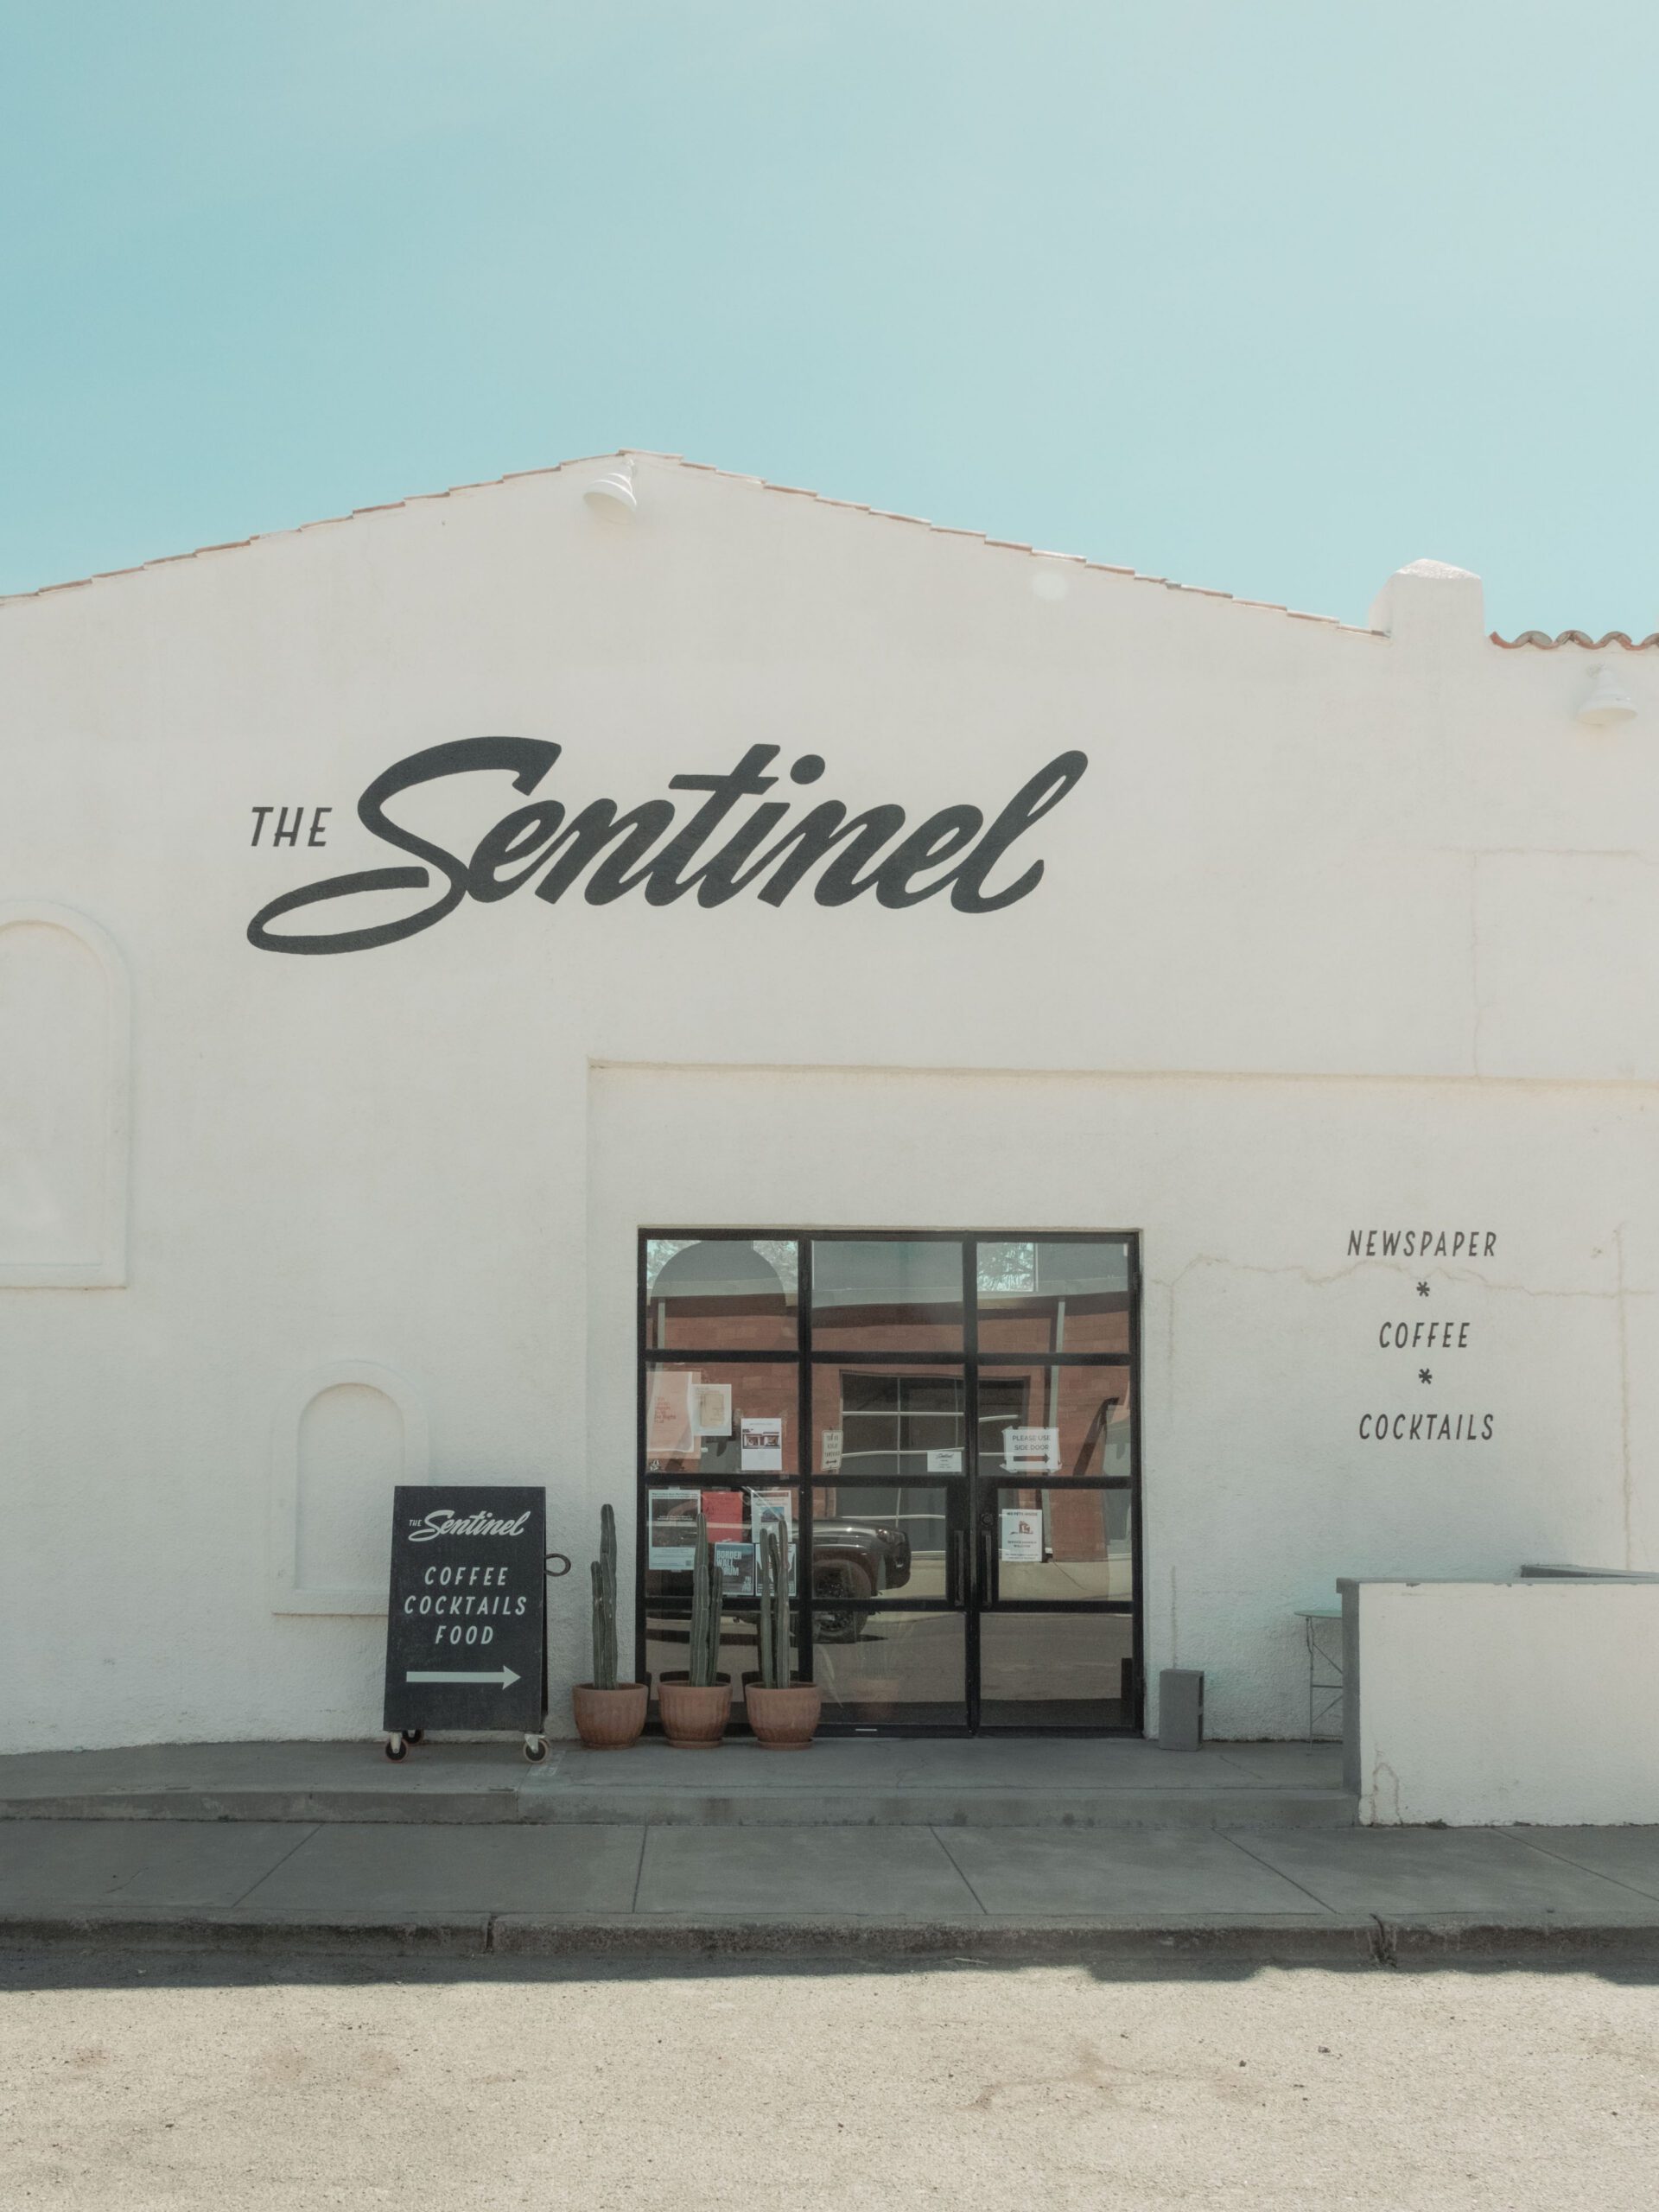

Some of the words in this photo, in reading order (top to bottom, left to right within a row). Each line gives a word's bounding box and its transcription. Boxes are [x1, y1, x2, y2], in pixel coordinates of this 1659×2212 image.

[251, 806, 333, 848] THE
[247, 736, 1089, 956] Sentinel
[1347, 1230, 1497, 1257] NEWSPAPER
[1379, 1321, 1471, 1349] COFFEE
[1359, 1413, 1494, 1440] COCKTAILS
[408, 1509, 531, 1542] Sentinel
[716, 1550, 742, 1560] BORDER
[424, 1566, 509, 1586] COFFEE
[404, 1595, 527, 1616] COCKTAILS
[435, 1624, 493, 1645] FOOD
